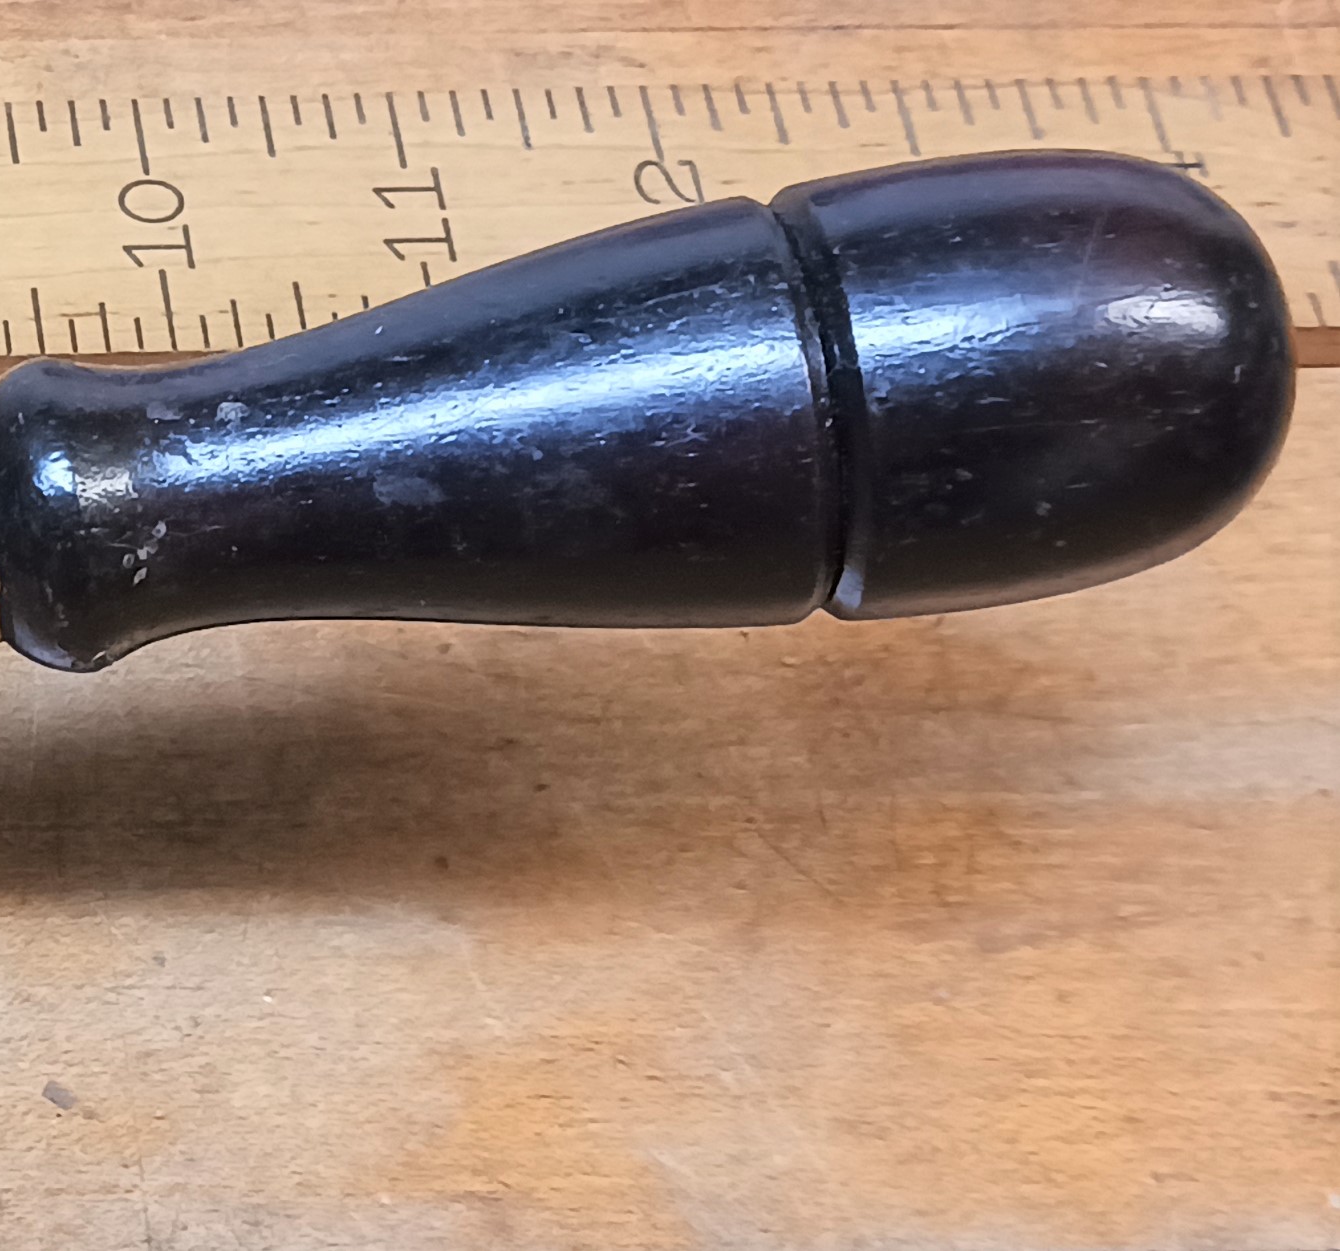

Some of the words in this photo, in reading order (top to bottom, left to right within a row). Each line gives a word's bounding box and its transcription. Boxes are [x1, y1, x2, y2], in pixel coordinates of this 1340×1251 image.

[118, 178, 196, 270] 10
[371, 166, 459, 262] 11
[633, 159, 705, 205] 2
